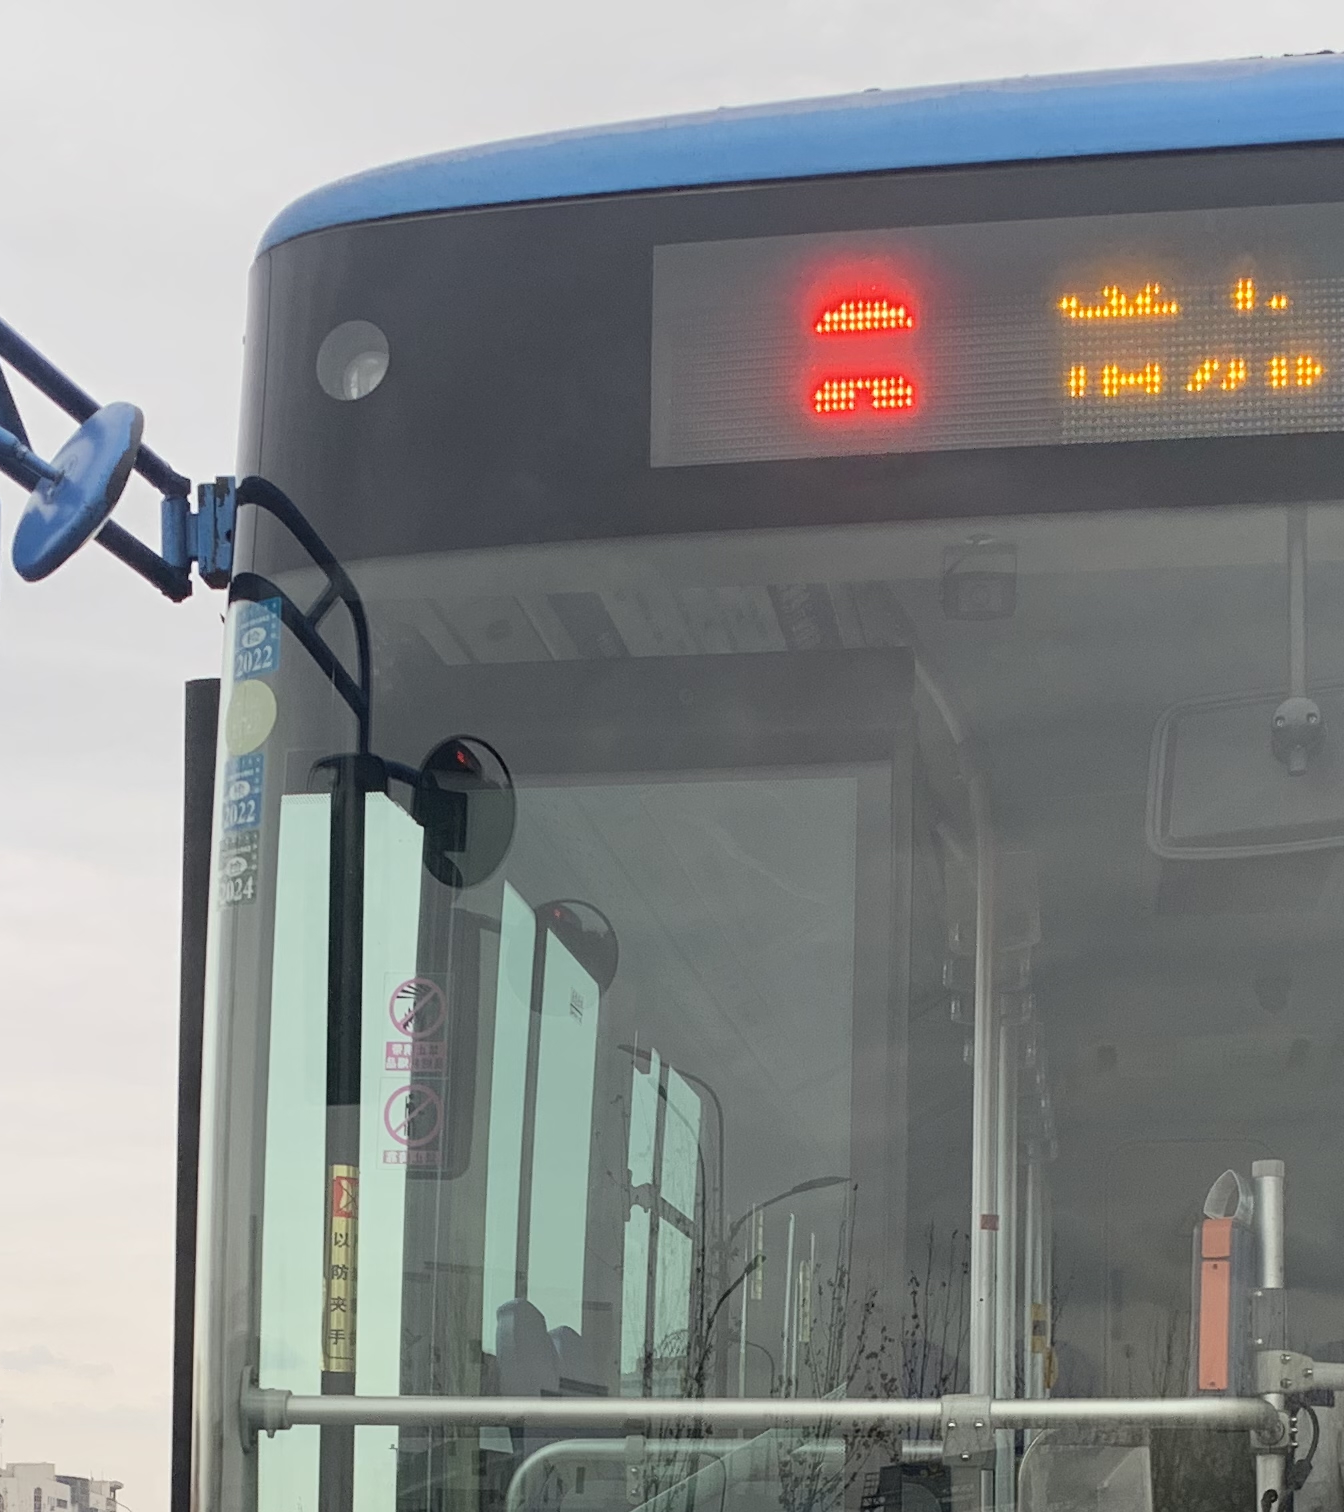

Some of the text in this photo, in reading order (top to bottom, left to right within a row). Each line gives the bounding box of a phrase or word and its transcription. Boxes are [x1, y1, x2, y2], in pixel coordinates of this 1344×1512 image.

[236, 645, 273, 678] 2022
[328, 1231, 350, 1346] 以防夹手
